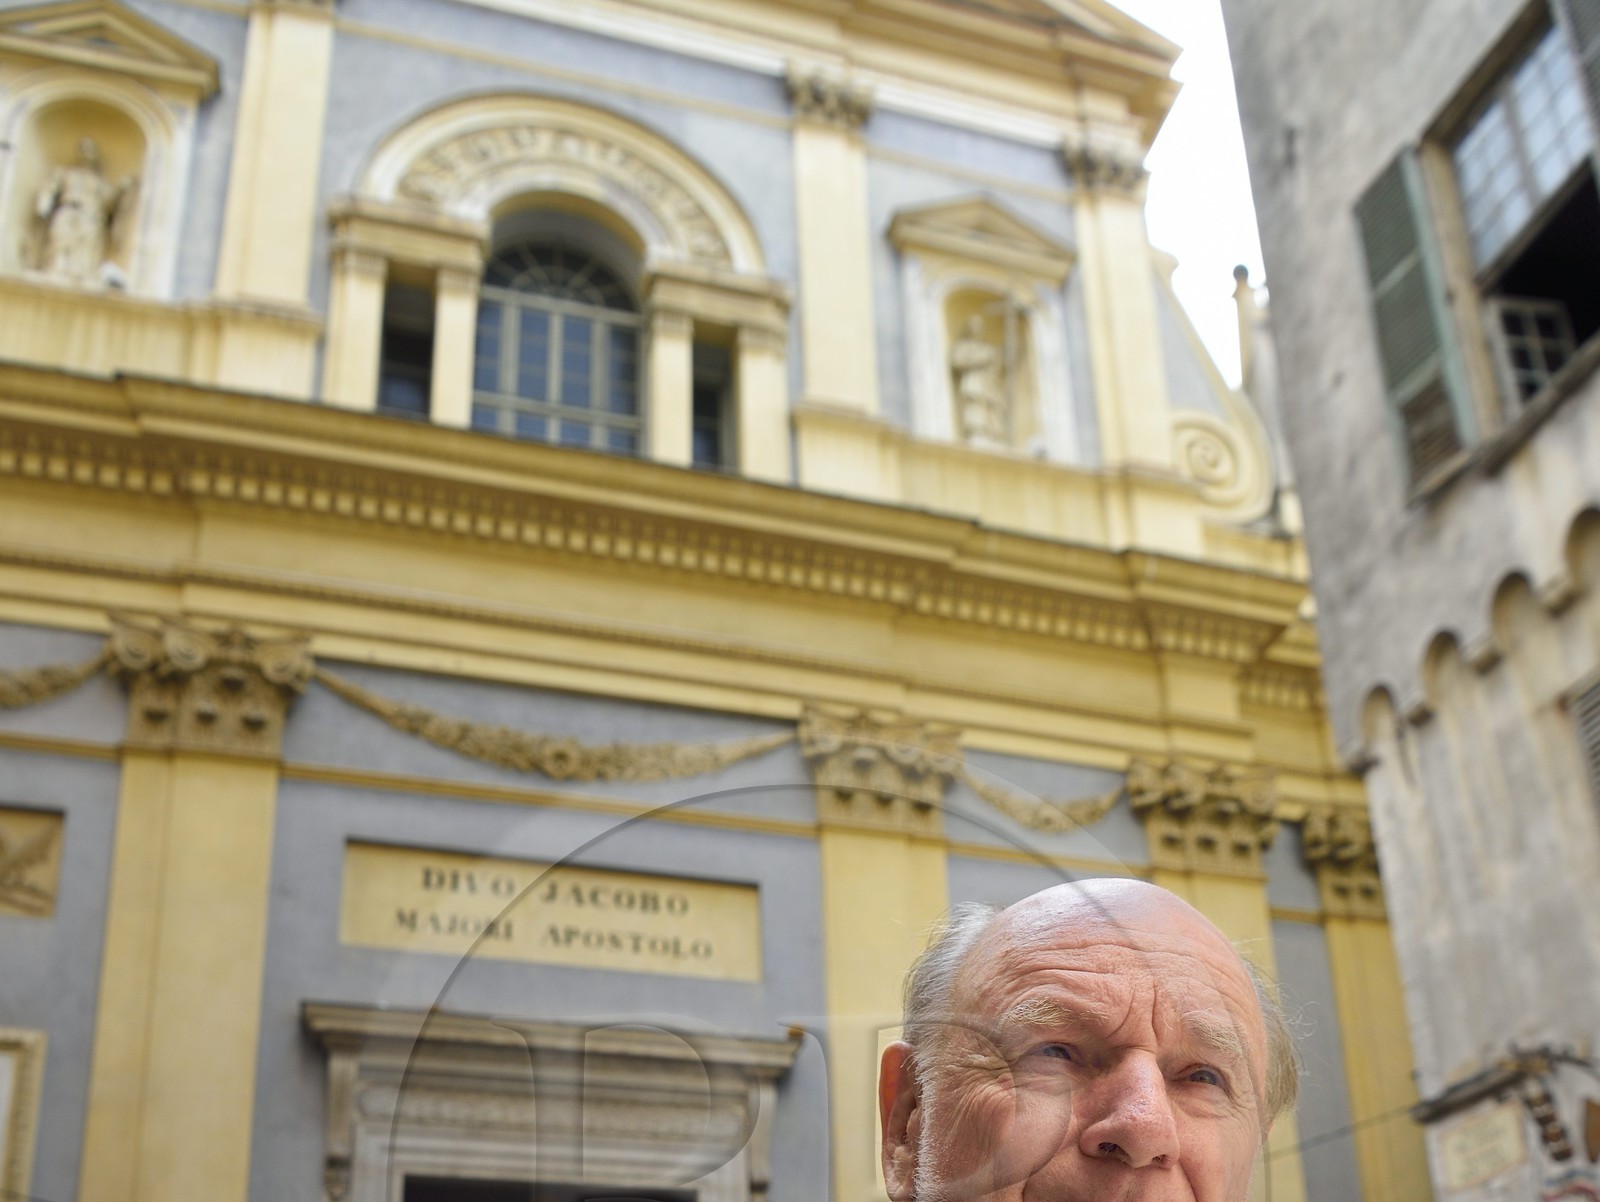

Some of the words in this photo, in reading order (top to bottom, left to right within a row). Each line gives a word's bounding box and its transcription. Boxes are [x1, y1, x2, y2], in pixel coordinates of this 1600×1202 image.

[421, 867, 515, 897] DIVO
[541, 881, 690, 917] JACOBO
[543, 925, 713, 960] APOSTOLO
